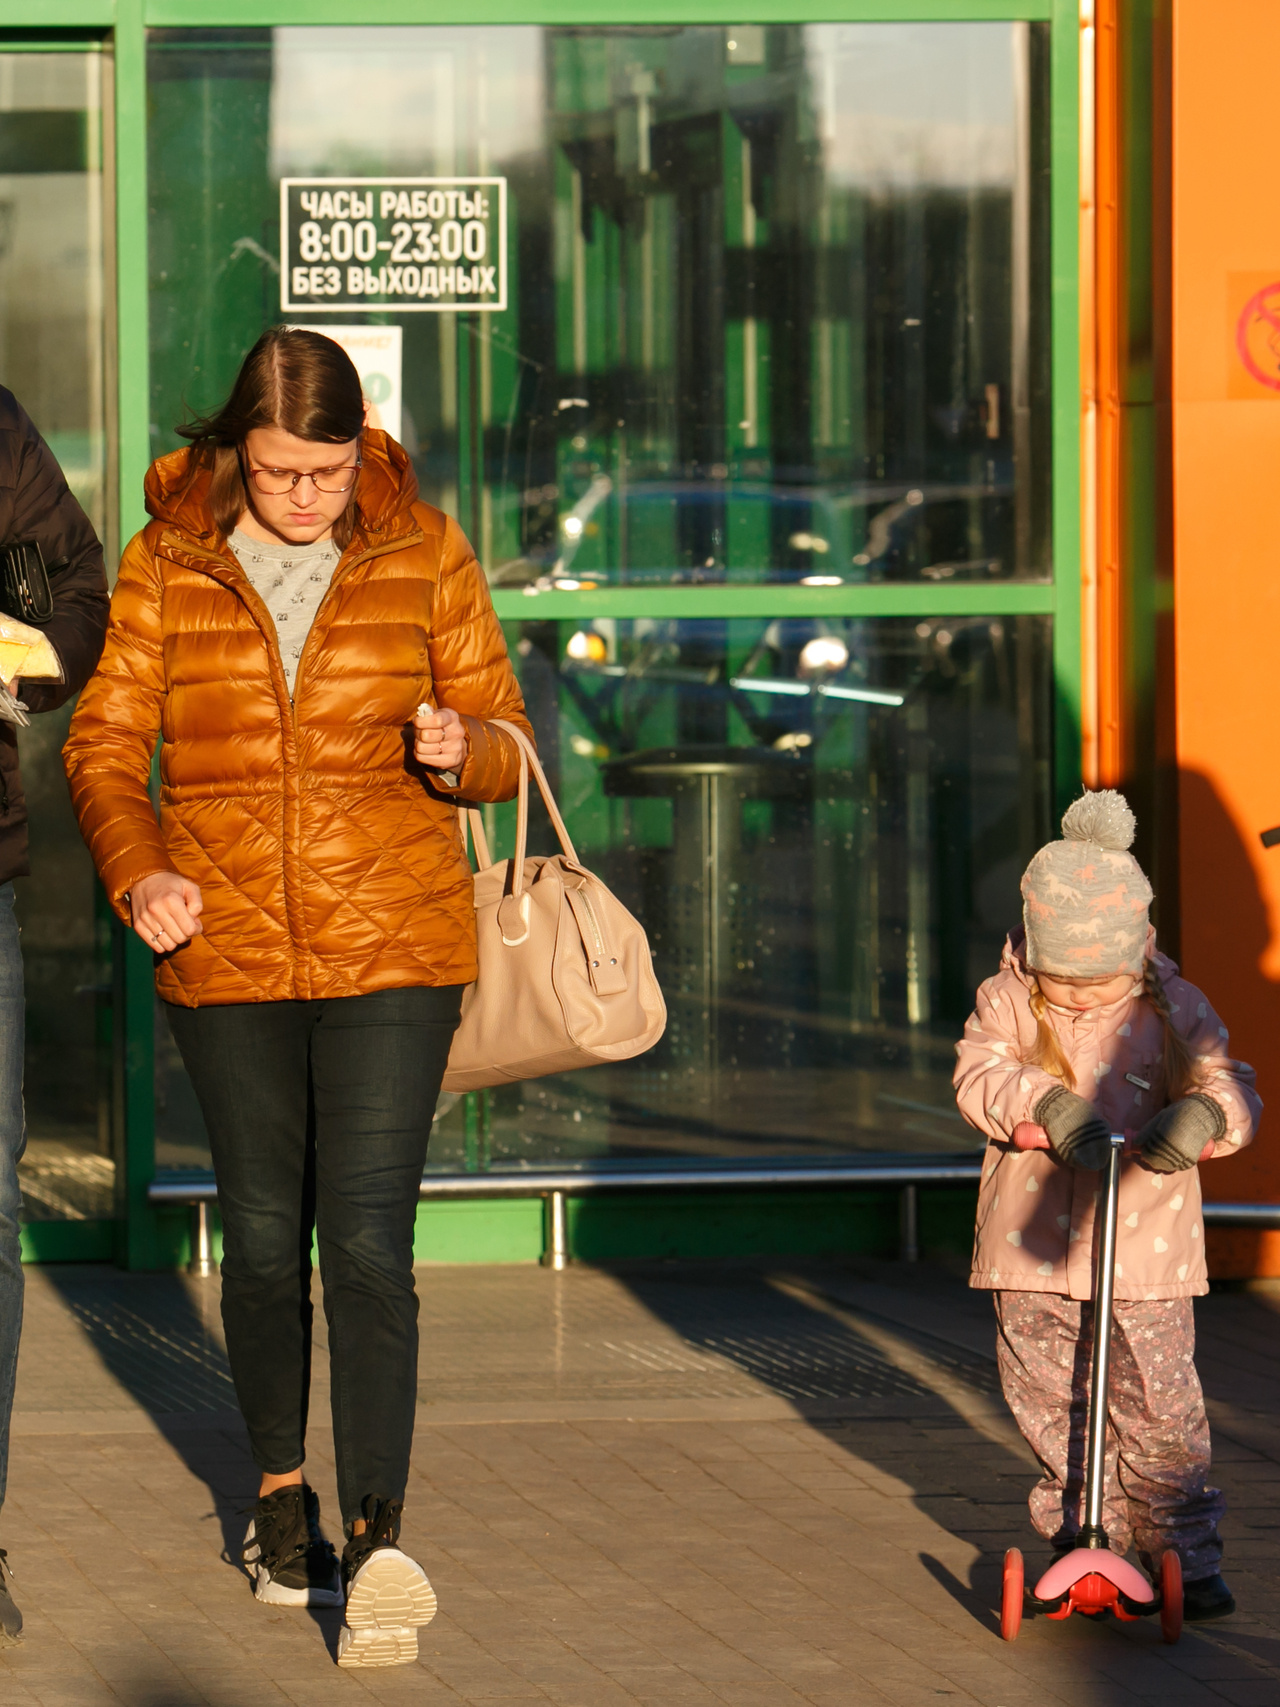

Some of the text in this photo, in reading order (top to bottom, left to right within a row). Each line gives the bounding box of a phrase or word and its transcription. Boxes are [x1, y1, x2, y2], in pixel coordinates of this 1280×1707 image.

[300, 191, 489, 219] ЧАСЫ РАБОТЫ:
[299, 220, 486, 263] 8:00-23:00
[292, 266, 496, 298] БЕЗ ВЫХОДНЫХ
